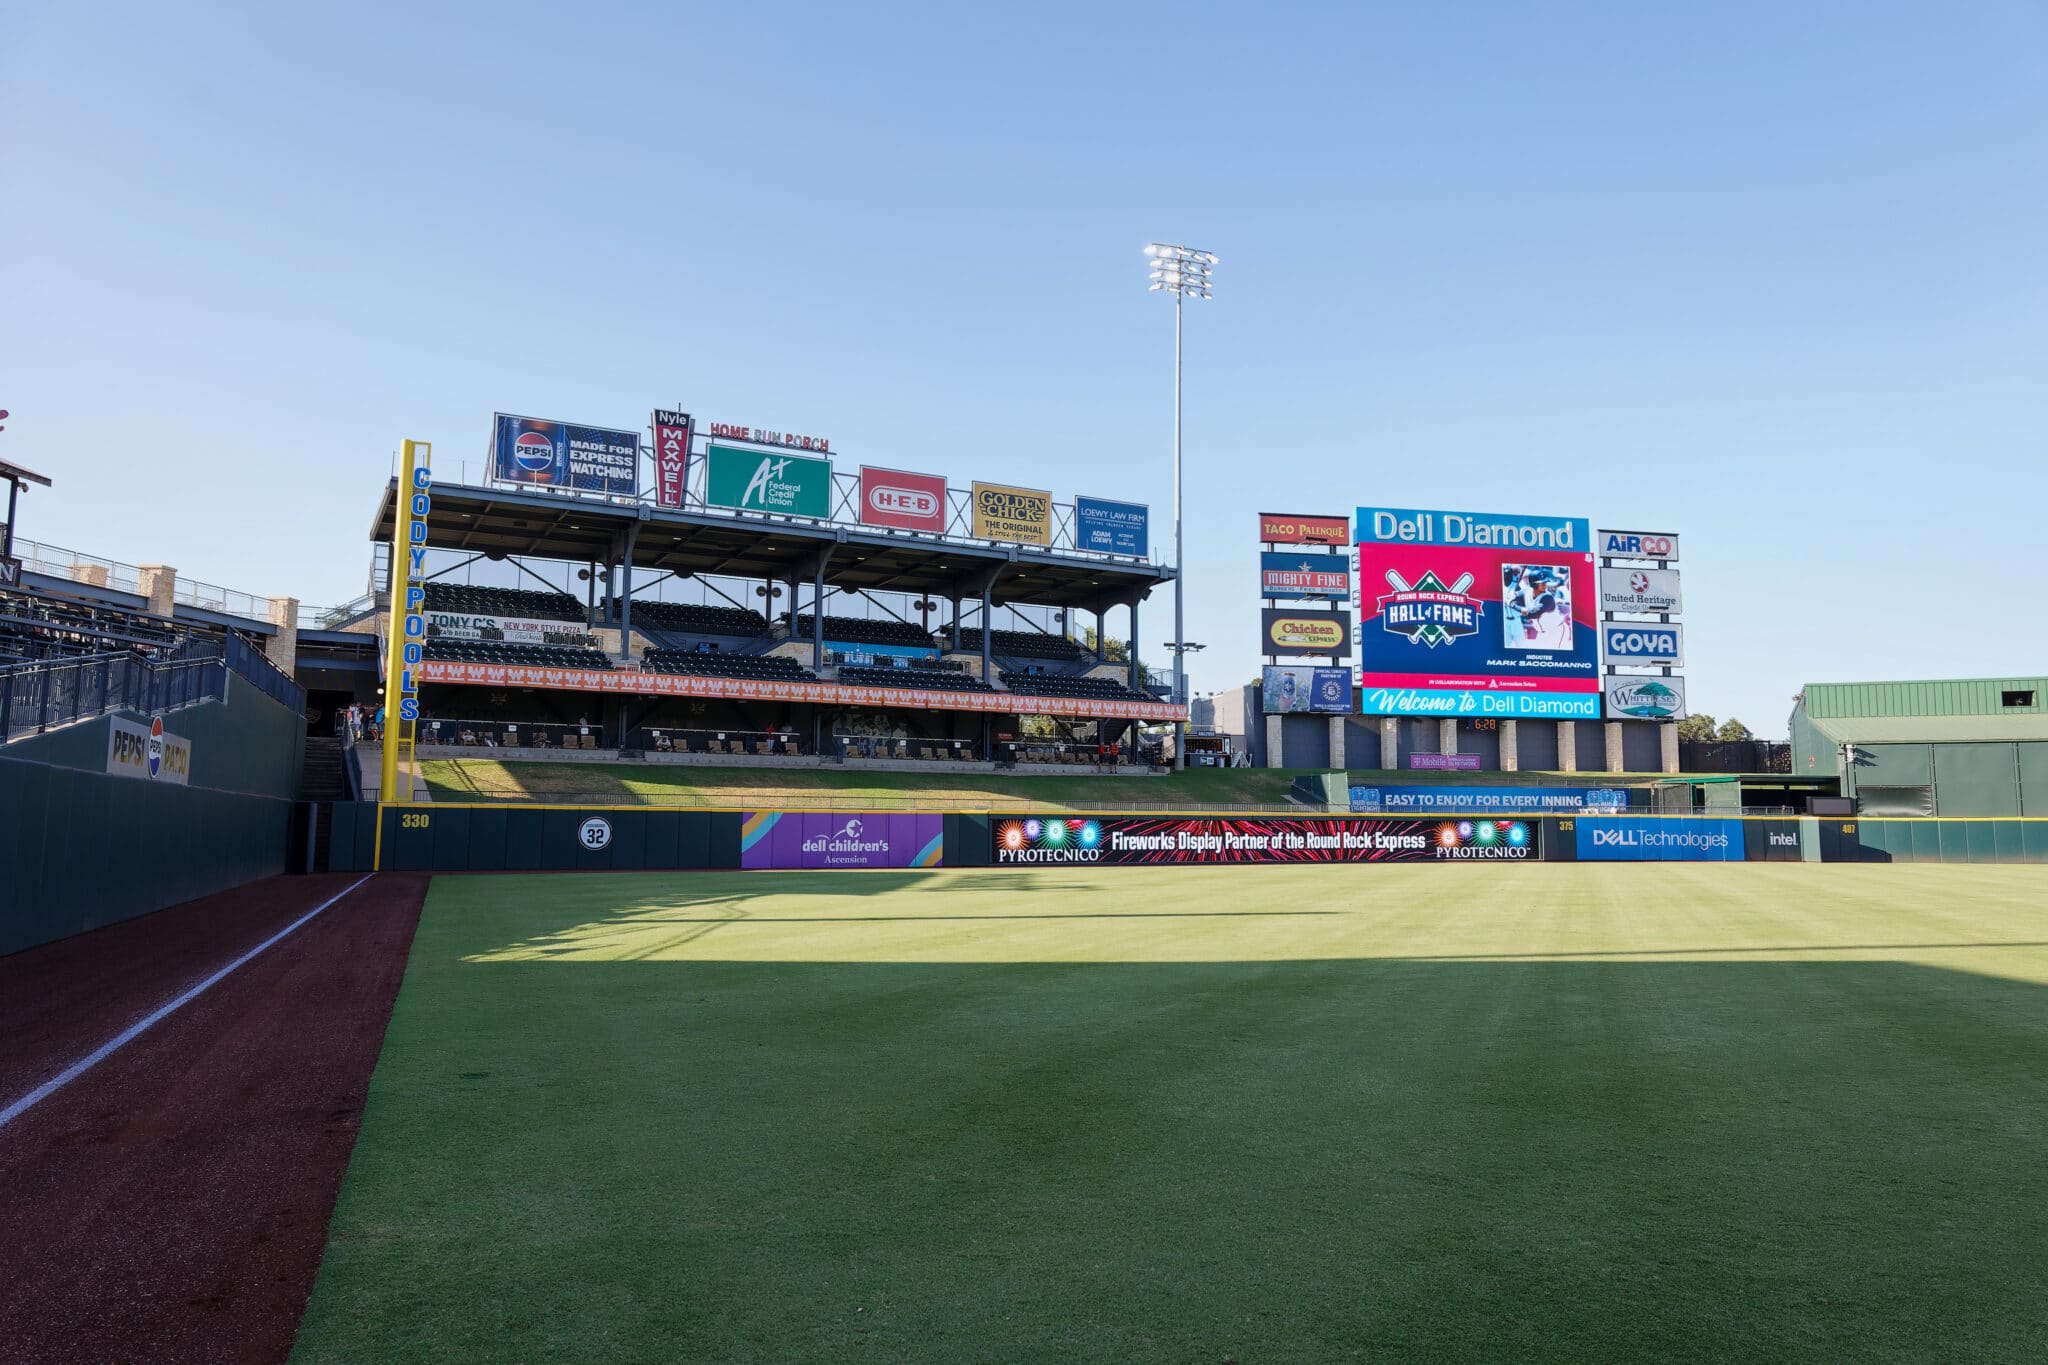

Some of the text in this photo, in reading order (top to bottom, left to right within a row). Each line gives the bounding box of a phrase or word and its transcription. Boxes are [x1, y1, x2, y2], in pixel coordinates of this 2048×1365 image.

[659, 411, 687, 425] Nyle
[710, 422, 829, 451] HOME RUN PORCH
[516, 445, 552, 458] PEPSI
[569, 440, 634, 456] MADE FOR
[570, 450, 634, 467] EXPRESS
[570, 461, 633, 480] WATCHING
[661, 428, 683, 505] MAXWELL
[768, 480, 801, 492] Federal
[768, 488, 795, 499] Credit
[768, 495, 793, 506] Union
[979, 490, 1046, 511] GOLDEN
[409, 467, 431, 570] CODY
[986, 504, 1040, 521] CHICK
[1081, 507, 1145, 523] LOEWY LAW FIRM
[984, 520, 1000, 529] THE
[1002, 522, 1043, 535] ORIGINAL
[1264, 524, 1345, 538] TACO PALENQUE
[1375, 511, 1574, 549] Dell Diamond
[1092, 530, 1112, 538] ADAM
[1268, 572, 1344, 587] MIGHTY FINE
[1436, 593, 1465, 603] EXPRESS
[1604, 593, 1677, 607] United Heritage
[430, 614, 475, 629] TONY
[1389, 603, 1426, 624] HALL
[1433, 603, 1473, 626] FAME
[503, 621, 520, 630] NEW
[521, 622, 538, 632] YORK
[540, 624, 561, 633] STYLE
[1281, 622, 1335, 635] Chicken
[1610, 632, 1675, 654] GOYA
[400, 586, 425, 721] POOLS
[1486, 659, 1593, 669] MARK SACCOMANNO
[1370, 688, 1595, 715] Welcome to Dell Diamond
[1612, 687, 1677, 706] WHITTSEY
[1474, 718, 1496, 730] 6:28
[112, 729, 146, 767] PEPSI
[164, 743, 187, 775] PATIO
[1385, 794, 1416, 806] EASY
[1417, 795, 1434, 806] TO
[1435, 795, 1474, 806] ENJOY
[1475, 796, 1501, 807] FOR
[1502, 796, 1539, 807] EVERY
[1541, 795, 1583, 807] INNING
[402, 814, 430, 828] 330
[1559, 821, 1574, 831] 375
[586, 828, 604, 844] 32
[1593, 830, 1729, 851] DELL Technologies
[802, 839, 889, 852] dell children's
[999, 831, 1528, 862] PYROTECNICO Fireworks Display Partner of the Round Rock Express PYROTECNICO
[824, 856, 868, 864] Ascension
